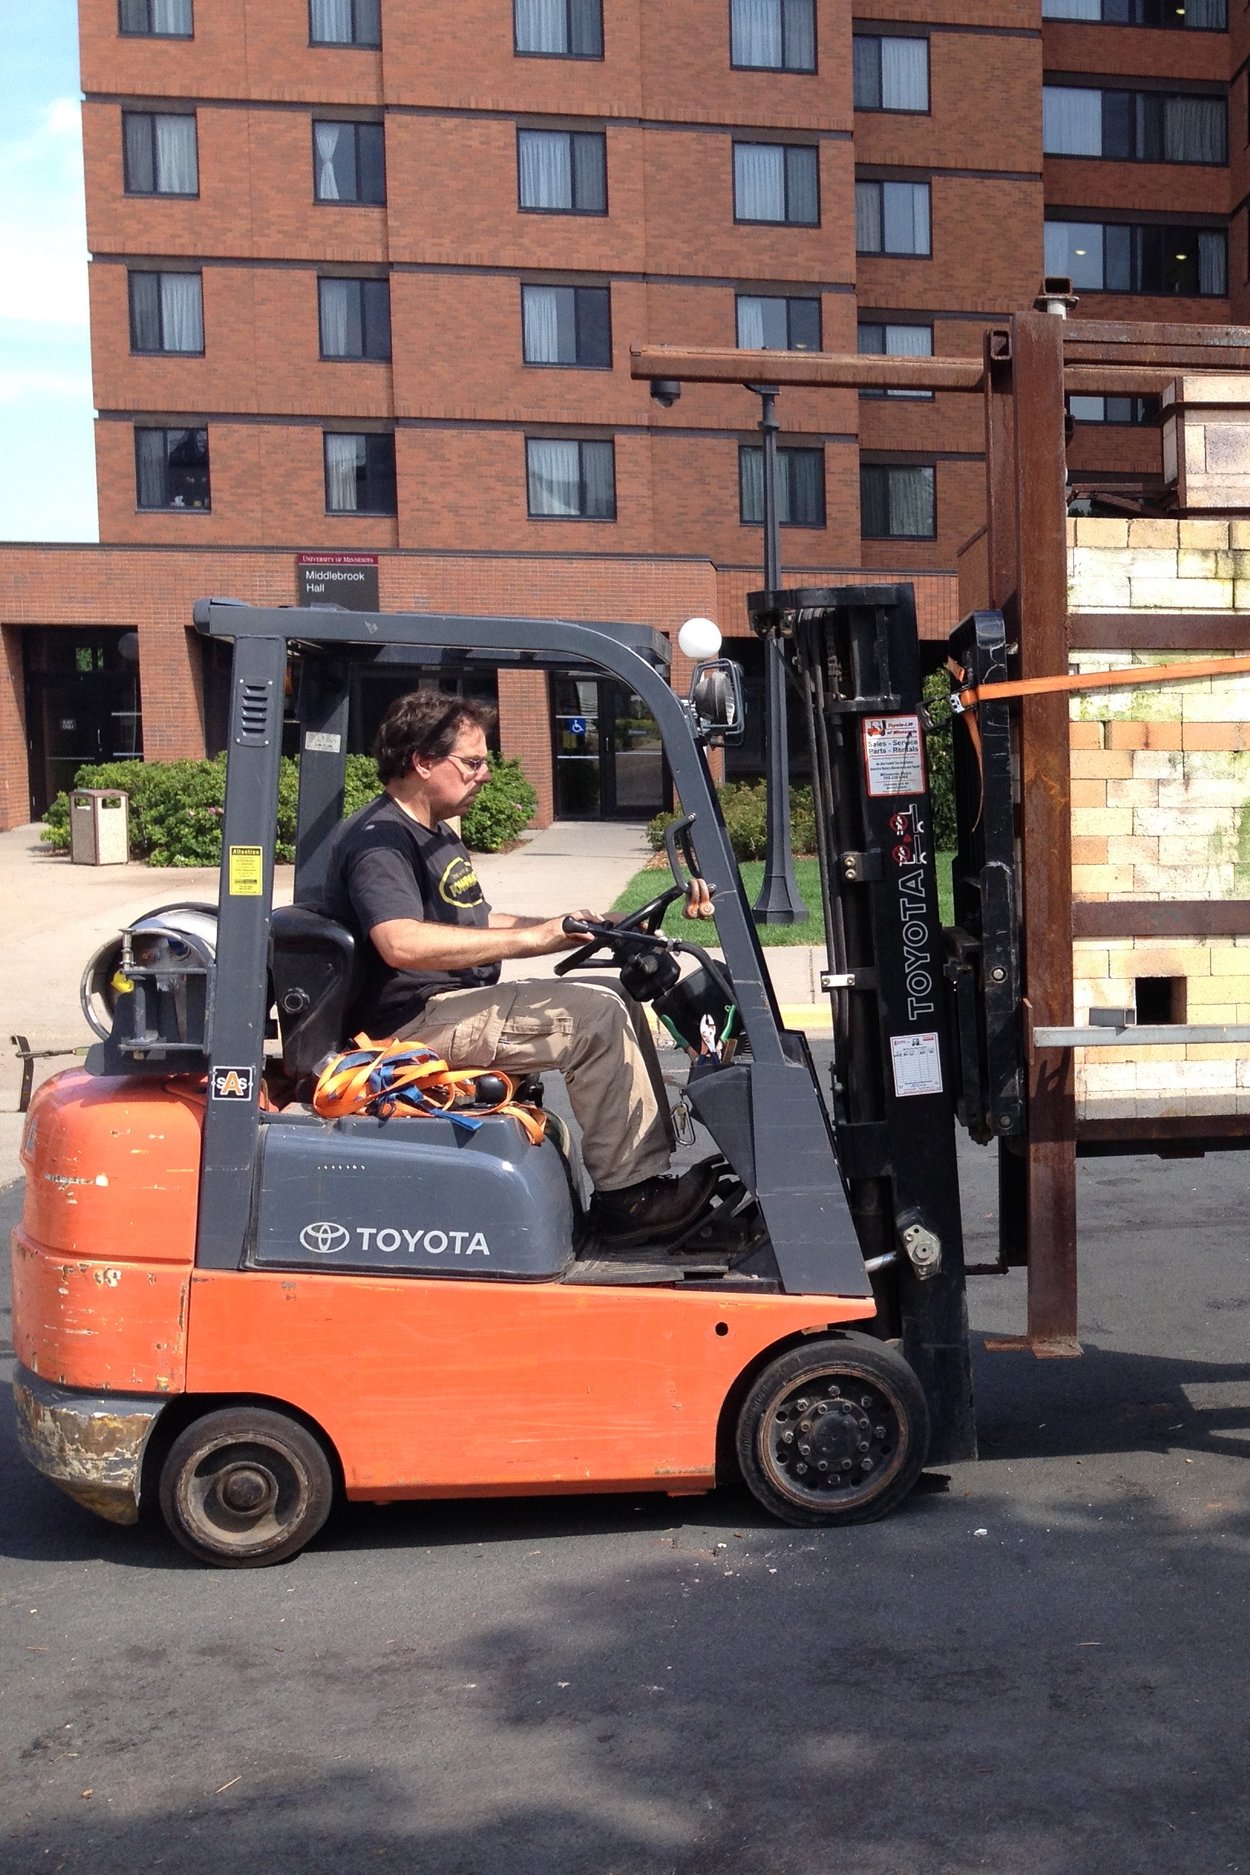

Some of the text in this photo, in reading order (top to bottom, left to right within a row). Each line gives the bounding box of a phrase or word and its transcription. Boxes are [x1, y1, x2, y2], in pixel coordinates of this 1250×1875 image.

[303, 555, 334, 563] UNIVERSITY
[305, 570, 365, 581] Middlebrook
[306, 583, 325, 593] Hall
[868, 740, 887, 748] Sales
[869, 747, 887, 755] Parts
[893, 746, 918, 754] Rentals
[899, 869, 934, 1021] TOYOTA
[356, 1227, 490, 1255] TOYOTA
